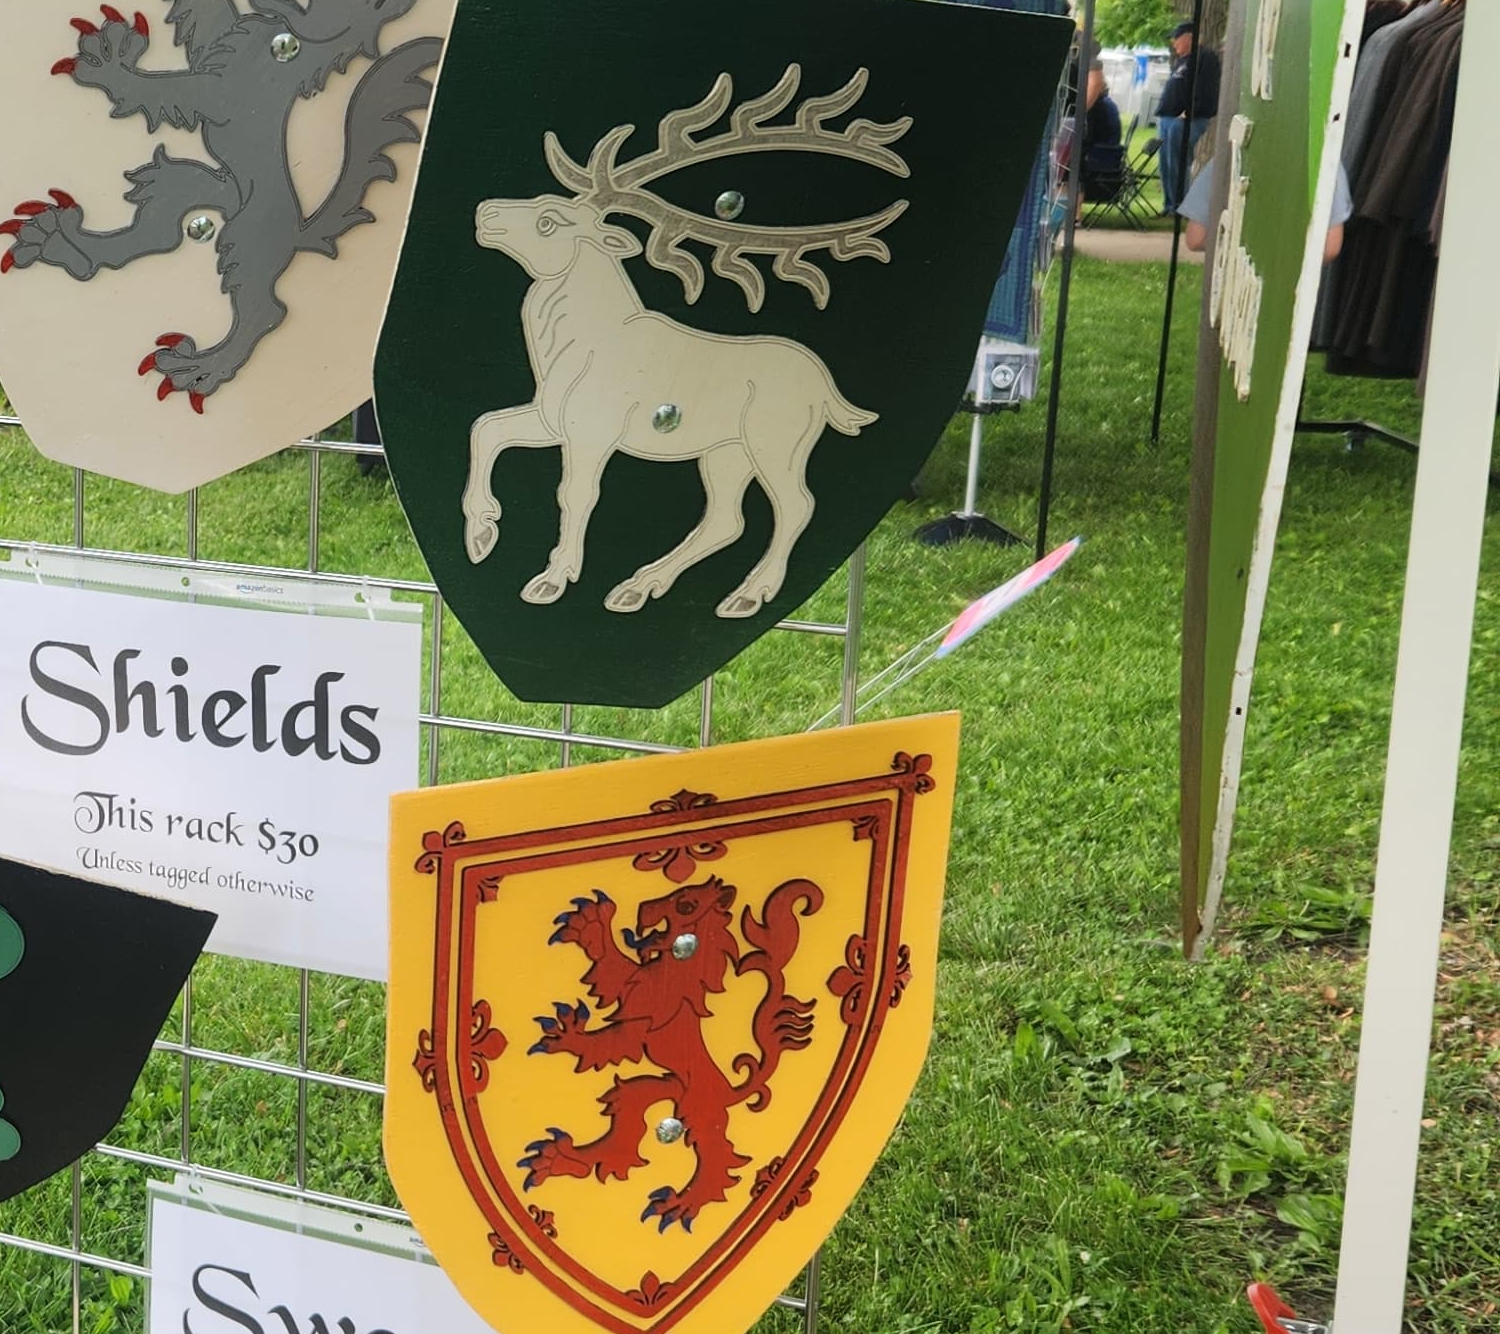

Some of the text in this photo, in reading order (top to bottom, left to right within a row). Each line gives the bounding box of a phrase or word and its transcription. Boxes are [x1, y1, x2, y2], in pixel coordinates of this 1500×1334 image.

[21, 640, 381, 765] Shields
[73, 791, 319, 865] This rack $30
[76, 846, 315, 903] Unless tagged otherwise
